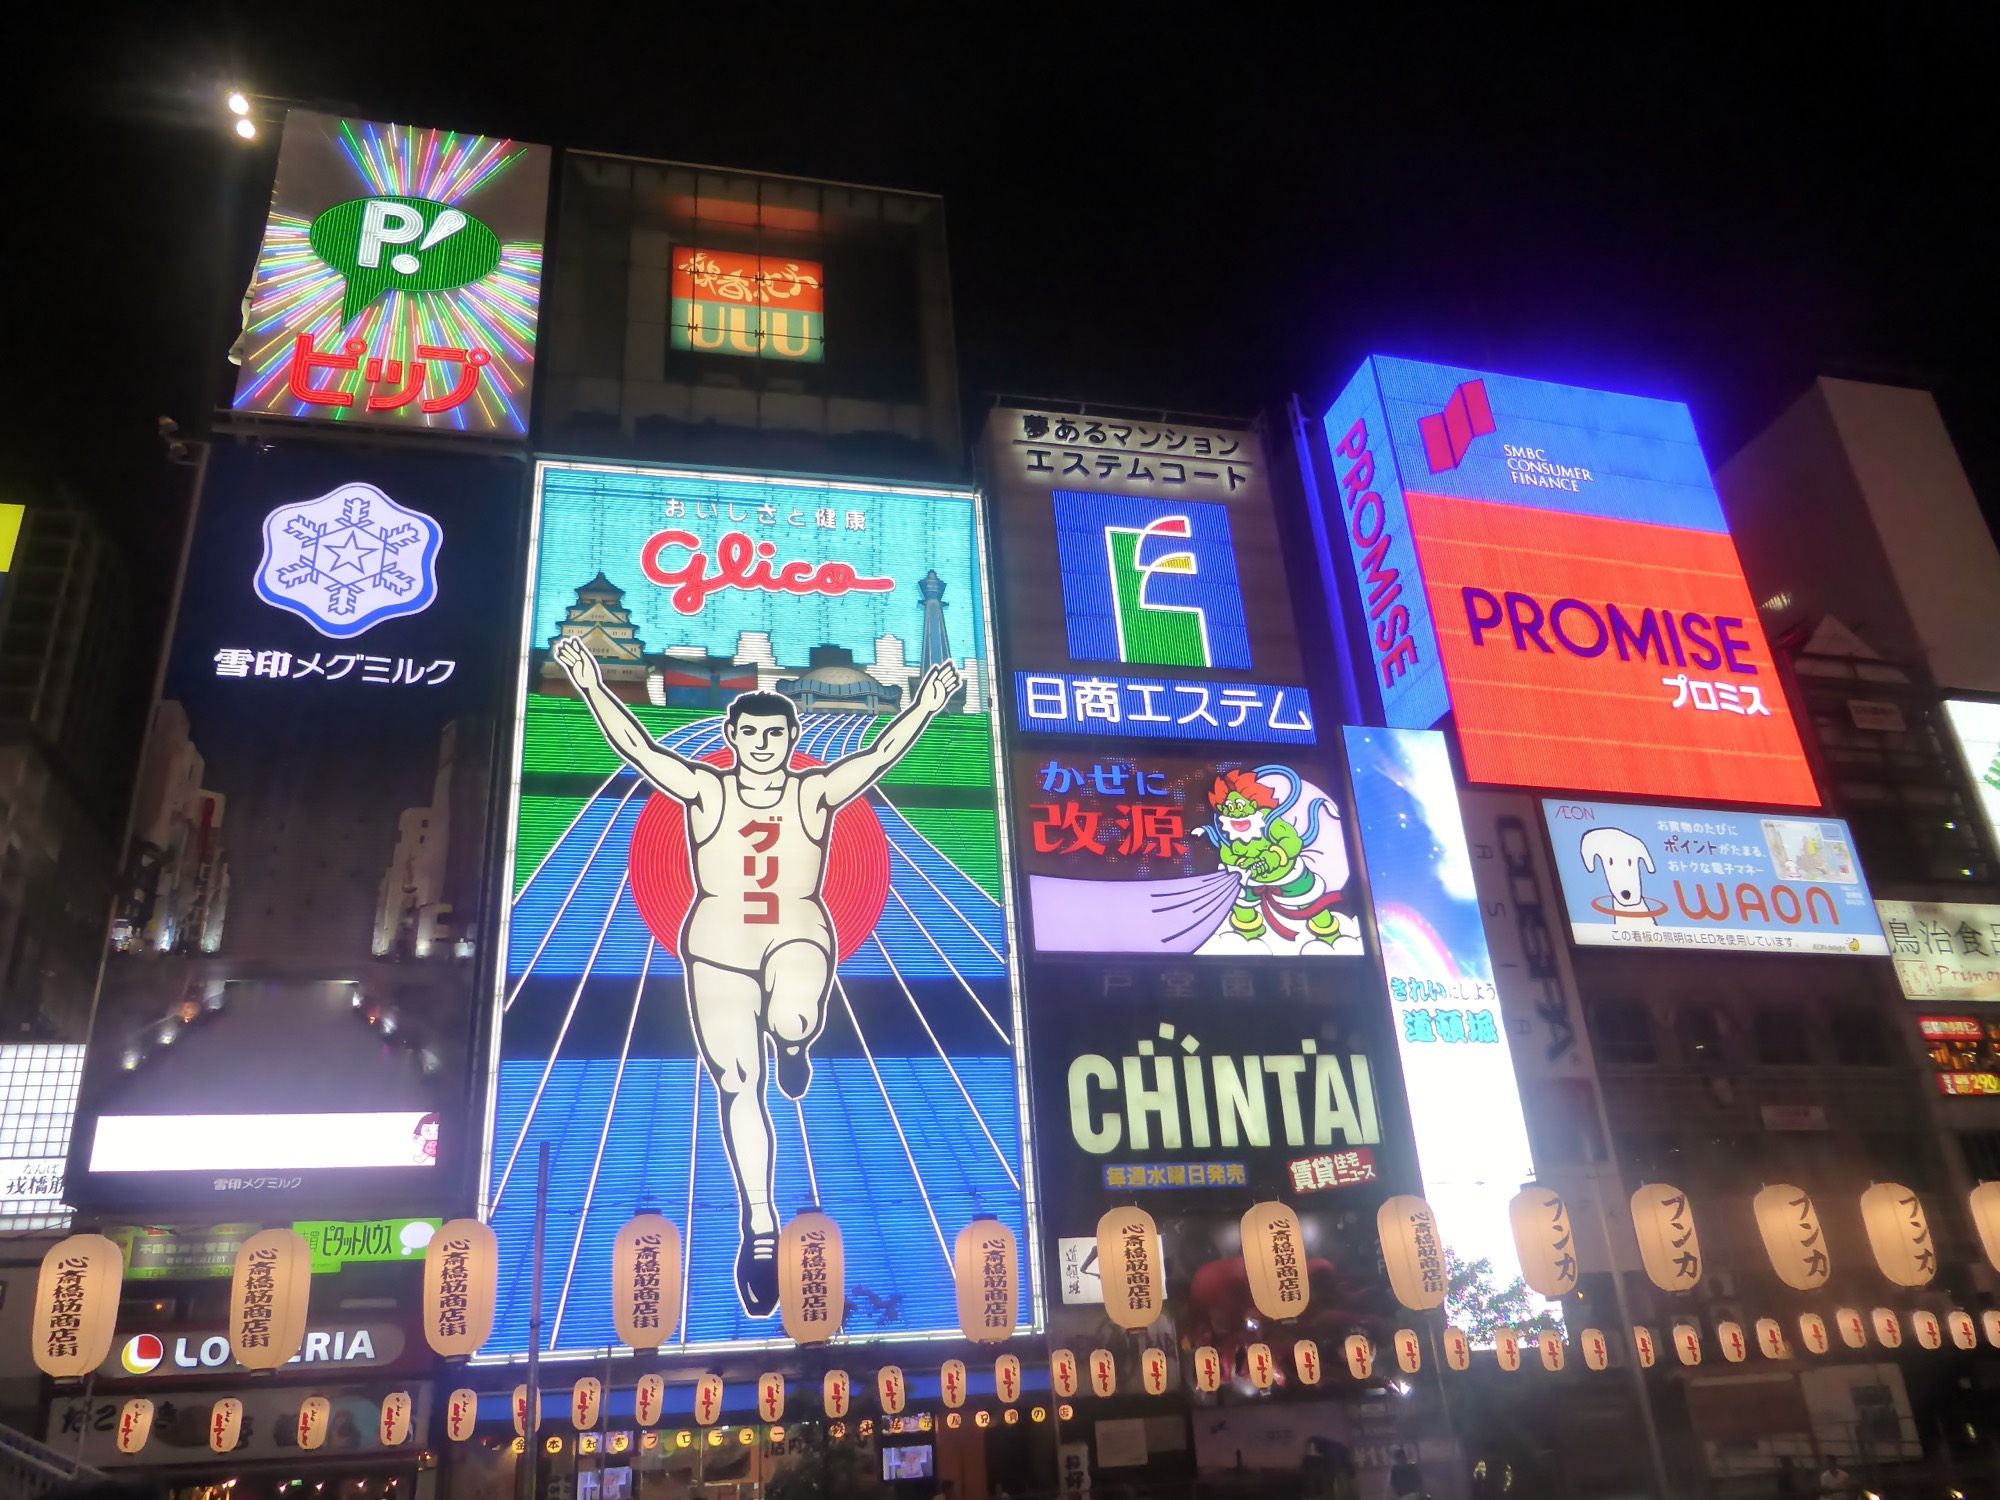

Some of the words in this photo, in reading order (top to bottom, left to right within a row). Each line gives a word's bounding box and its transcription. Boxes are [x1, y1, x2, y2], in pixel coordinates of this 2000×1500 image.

[289, 331, 492, 413] ピップ
[1022, 413, 1239, 456] 夢あるマンション
[1026, 449, 1247, 492] エステムコート
[1503, 444, 1547, 462] SMBC
[1507, 458, 1594, 483] CONSUMER
[1511, 471, 1580, 492] FINANCE
[665, 498, 867, 532] おいしさと健康
[1336, 418, 1419, 688] PROMISE
[1462, 586, 1758, 676] PROMISE
[213, 648, 456, 685] 雪印メグミルク
[1026, 677, 1312, 731] 日商エステム
[1662, 673, 1771, 716] プロミス
[1040, 761, 1170, 796] かぜに
[1029, 801, 1188, 858] 改源
[1656, 819, 1739, 836] お買物のたびに
[737, 816, 783, 924] グリコ
[1667, 860, 1764, 876] おトクな電子マネー
[1390, 976, 1496, 1002] きれいにしよう
[1402, 1008, 1499, 1044] 道頓堀
[213, 1177, 303, 1191] 雪印メグミルク
[1106, 1162, 1246, 1187] 毎週水曜日発売
[1338, 1164, 1376, 1183] ニュース
[322, 1223, 393, 1257] ピタットハウス
[174, 1330, 376, 1368] LORIA
